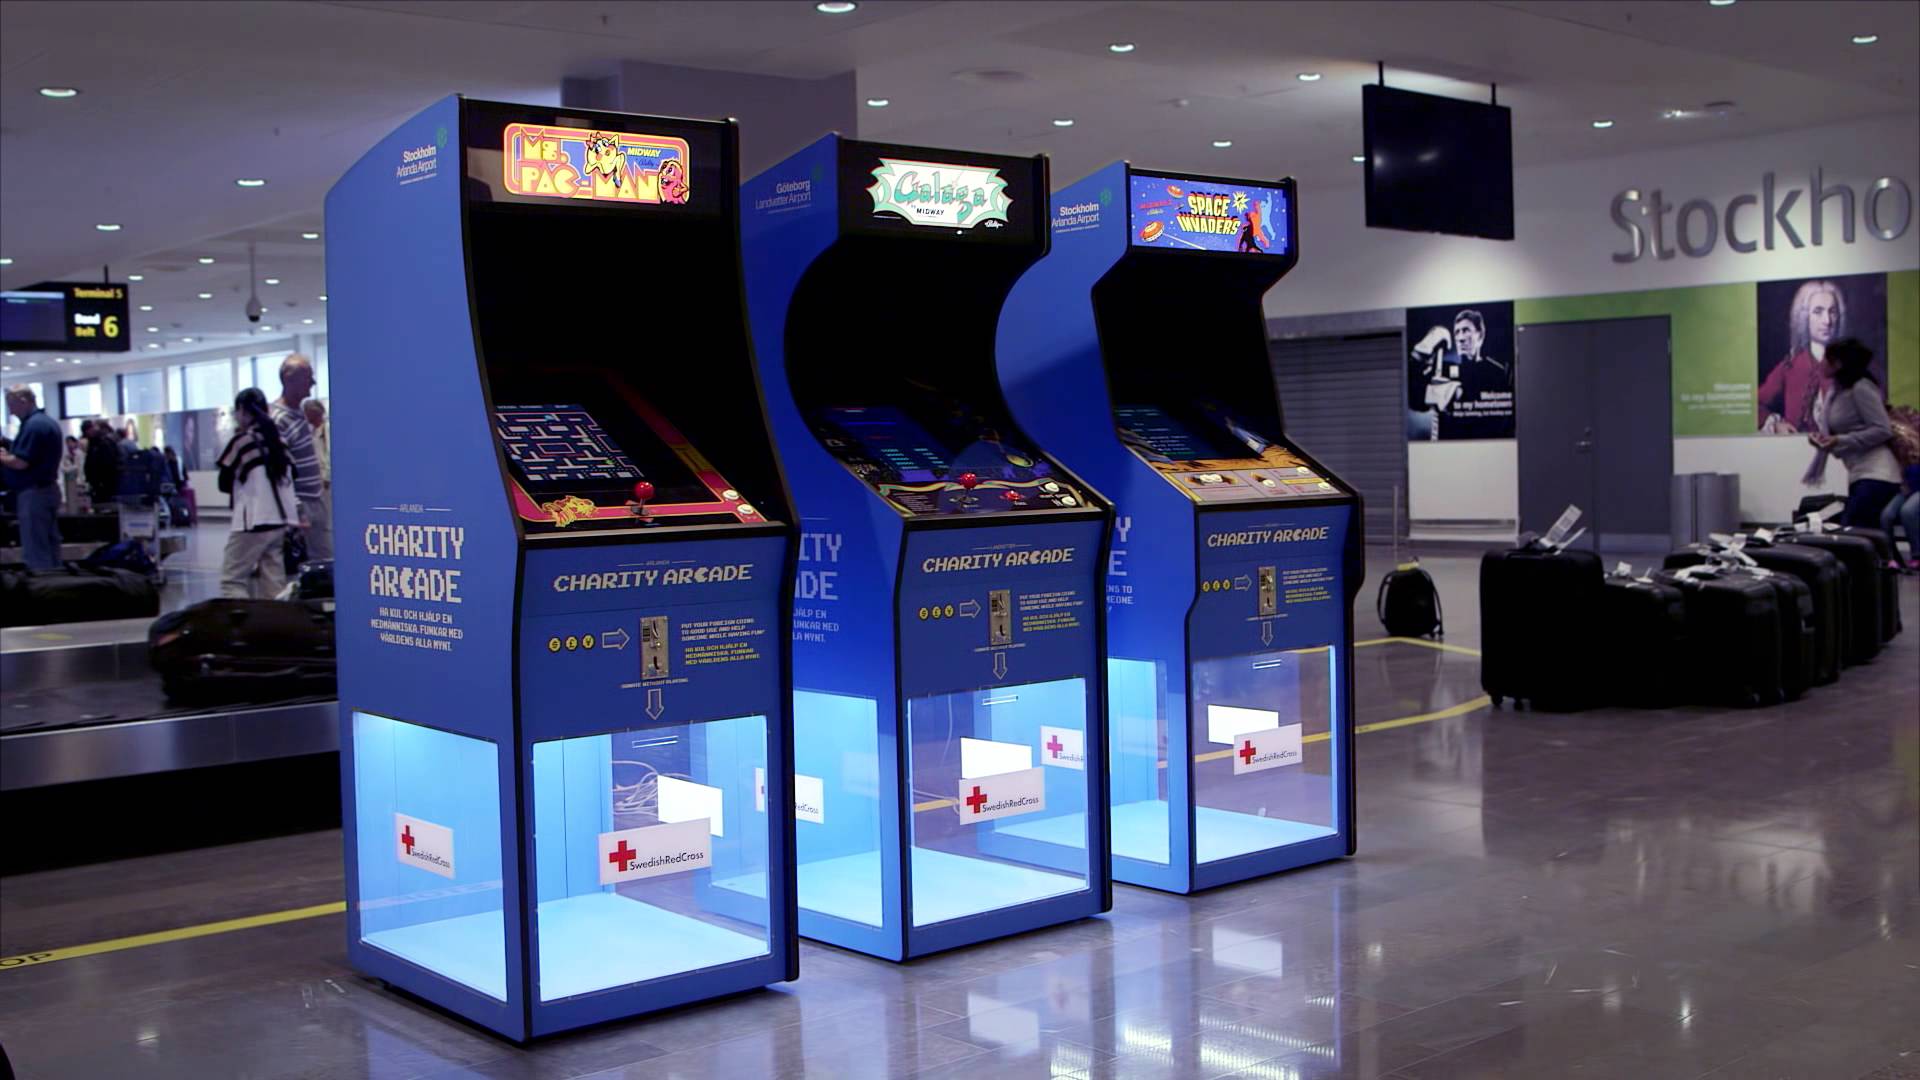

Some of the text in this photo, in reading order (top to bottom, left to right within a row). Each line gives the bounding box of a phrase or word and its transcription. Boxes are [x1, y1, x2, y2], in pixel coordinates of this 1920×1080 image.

[403, 144, 436, 163] Stockholm
[627, 147, 661, 157] MIDWAY
[396, 157, 437, 177] Arlanda Airport
[521, 165, 659, 200] PAC-MAN
[776, 180, 811, 194] Göteborg
[788, 192, 811, 205] Airport
[893, 170, 988, 224] Galaga
[1187, 192, 1231, 217] SPACE
[916, 208, 945, 216] MIDWAY
[1060, 202, 1099, 217] Stockholm
[1051, 212, 1099, 228] Arlanda Airport
[1176, 214, 1241, 235] INVADERS
[73, 287, 114, 299] Terminal
[103, 315, 119, 338] 6
[365, 523, 464, 560] CHARITY
[1207, 526, 1329, 547] CHARITY ARCADE
[922, 548, 1075, 573] CHARITY ARCADE
[370, 564, 462, 603] ARCADE
[553, 563, 754, 592] CHARITY ARCADE
[1122, 585, 1133, 594] TO
[379, 607, 389, 617] HA
[389, 607, 402, 618] KUL
[403, 609, 418, 620] OCH
[442, 613, 453, 624] EN
[815, 609, 827, 619] EN
[419, 624, 448, 637] FUNKAR
[448, 628, 464, 640] MED
[793, 619, 840, 632] UNKAR MED
[415, 637, 433, 649] ALLA
[792, 631, 802, 641] LA
[982, 796, 1039, 813] SwedishRedCross
[630, 852, 704, 870] SwedishRedCross
